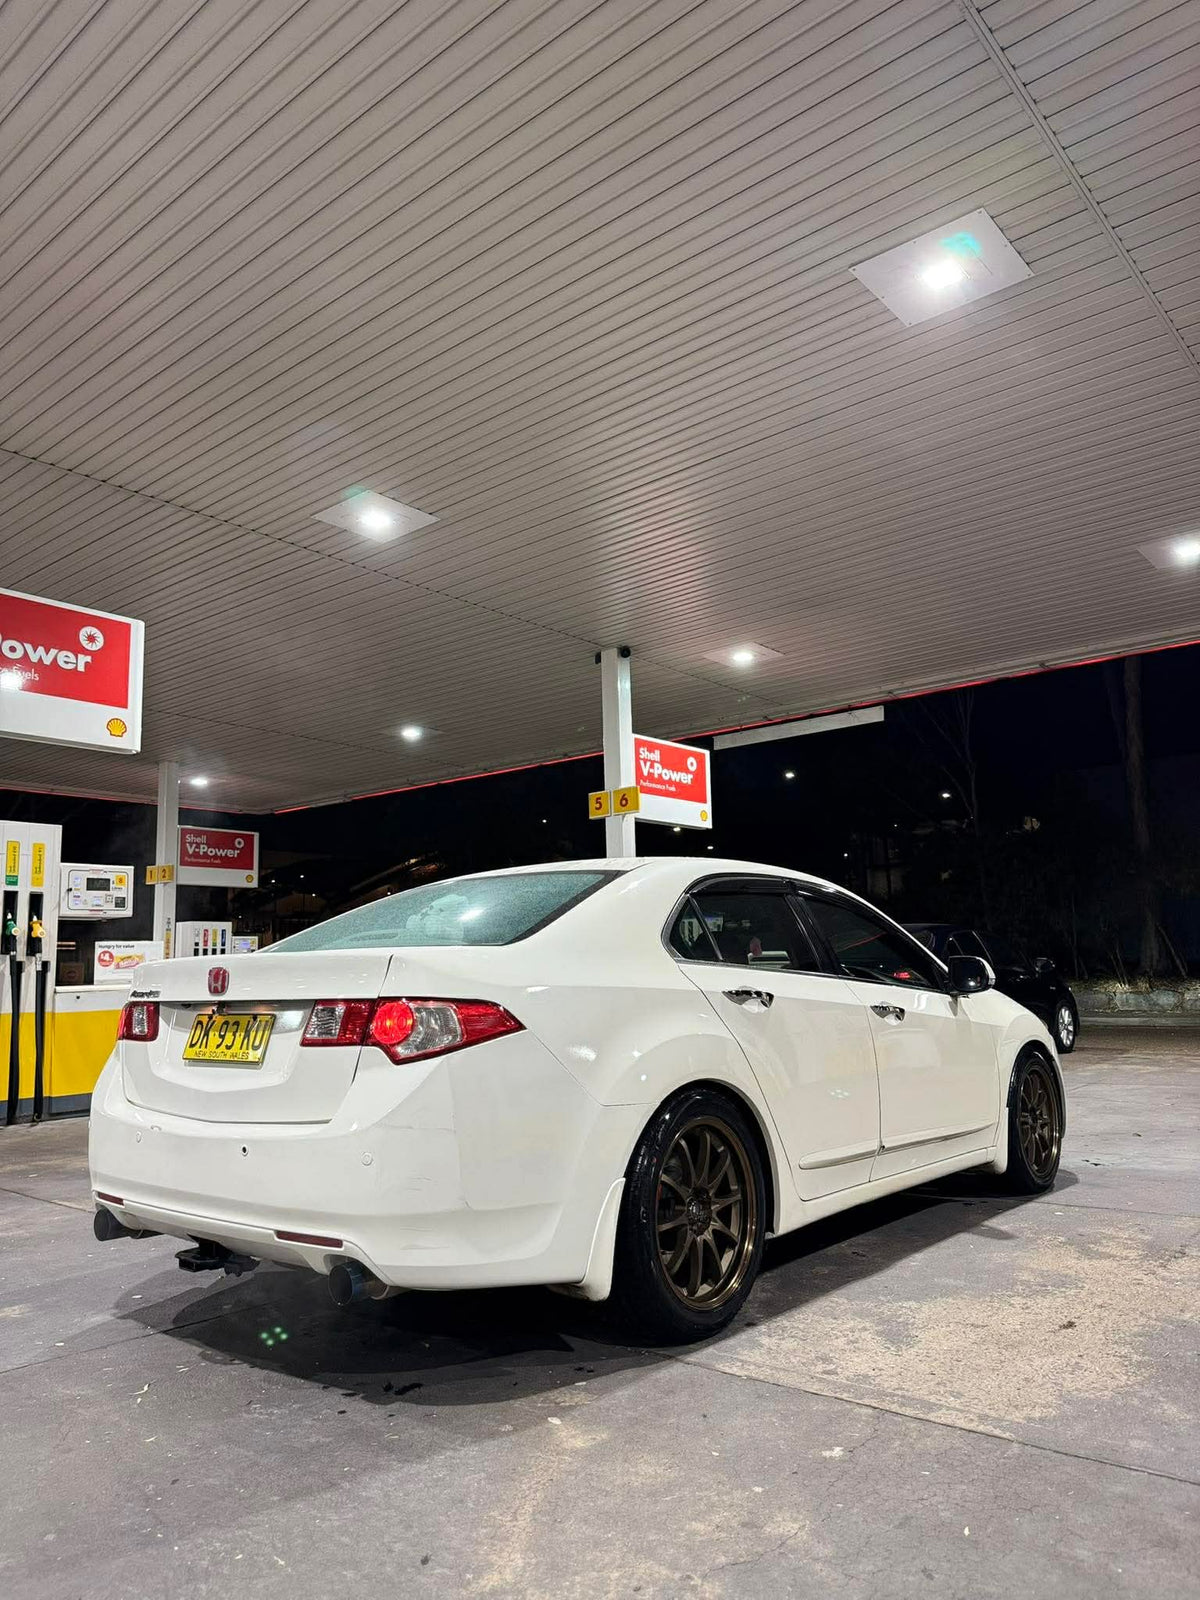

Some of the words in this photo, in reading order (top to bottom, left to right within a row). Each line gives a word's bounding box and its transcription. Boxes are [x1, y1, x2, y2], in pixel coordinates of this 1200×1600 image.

[0, 632, 92, 672] ower
[639, 747, 660, 761] Shell
[639, 760, 693, 785] V-Power
[594, 797, 603, 810] 5
[619, 793, 629, 807] 6
[185, 834, 207, 844] Shell
[186, 843, 240, 858] V-Power
[161, 868, 167, 879] 2
[188, 1019, 216, 1049] DK
[215, 1020, 240, 1050] 93
[240, 1020, 269, 1051] KU
[194, 1049, 207, 1057] NEW
[208, 1050, 227, 1058] SOUTH
[229, 1051, 250, 1060] WALES
